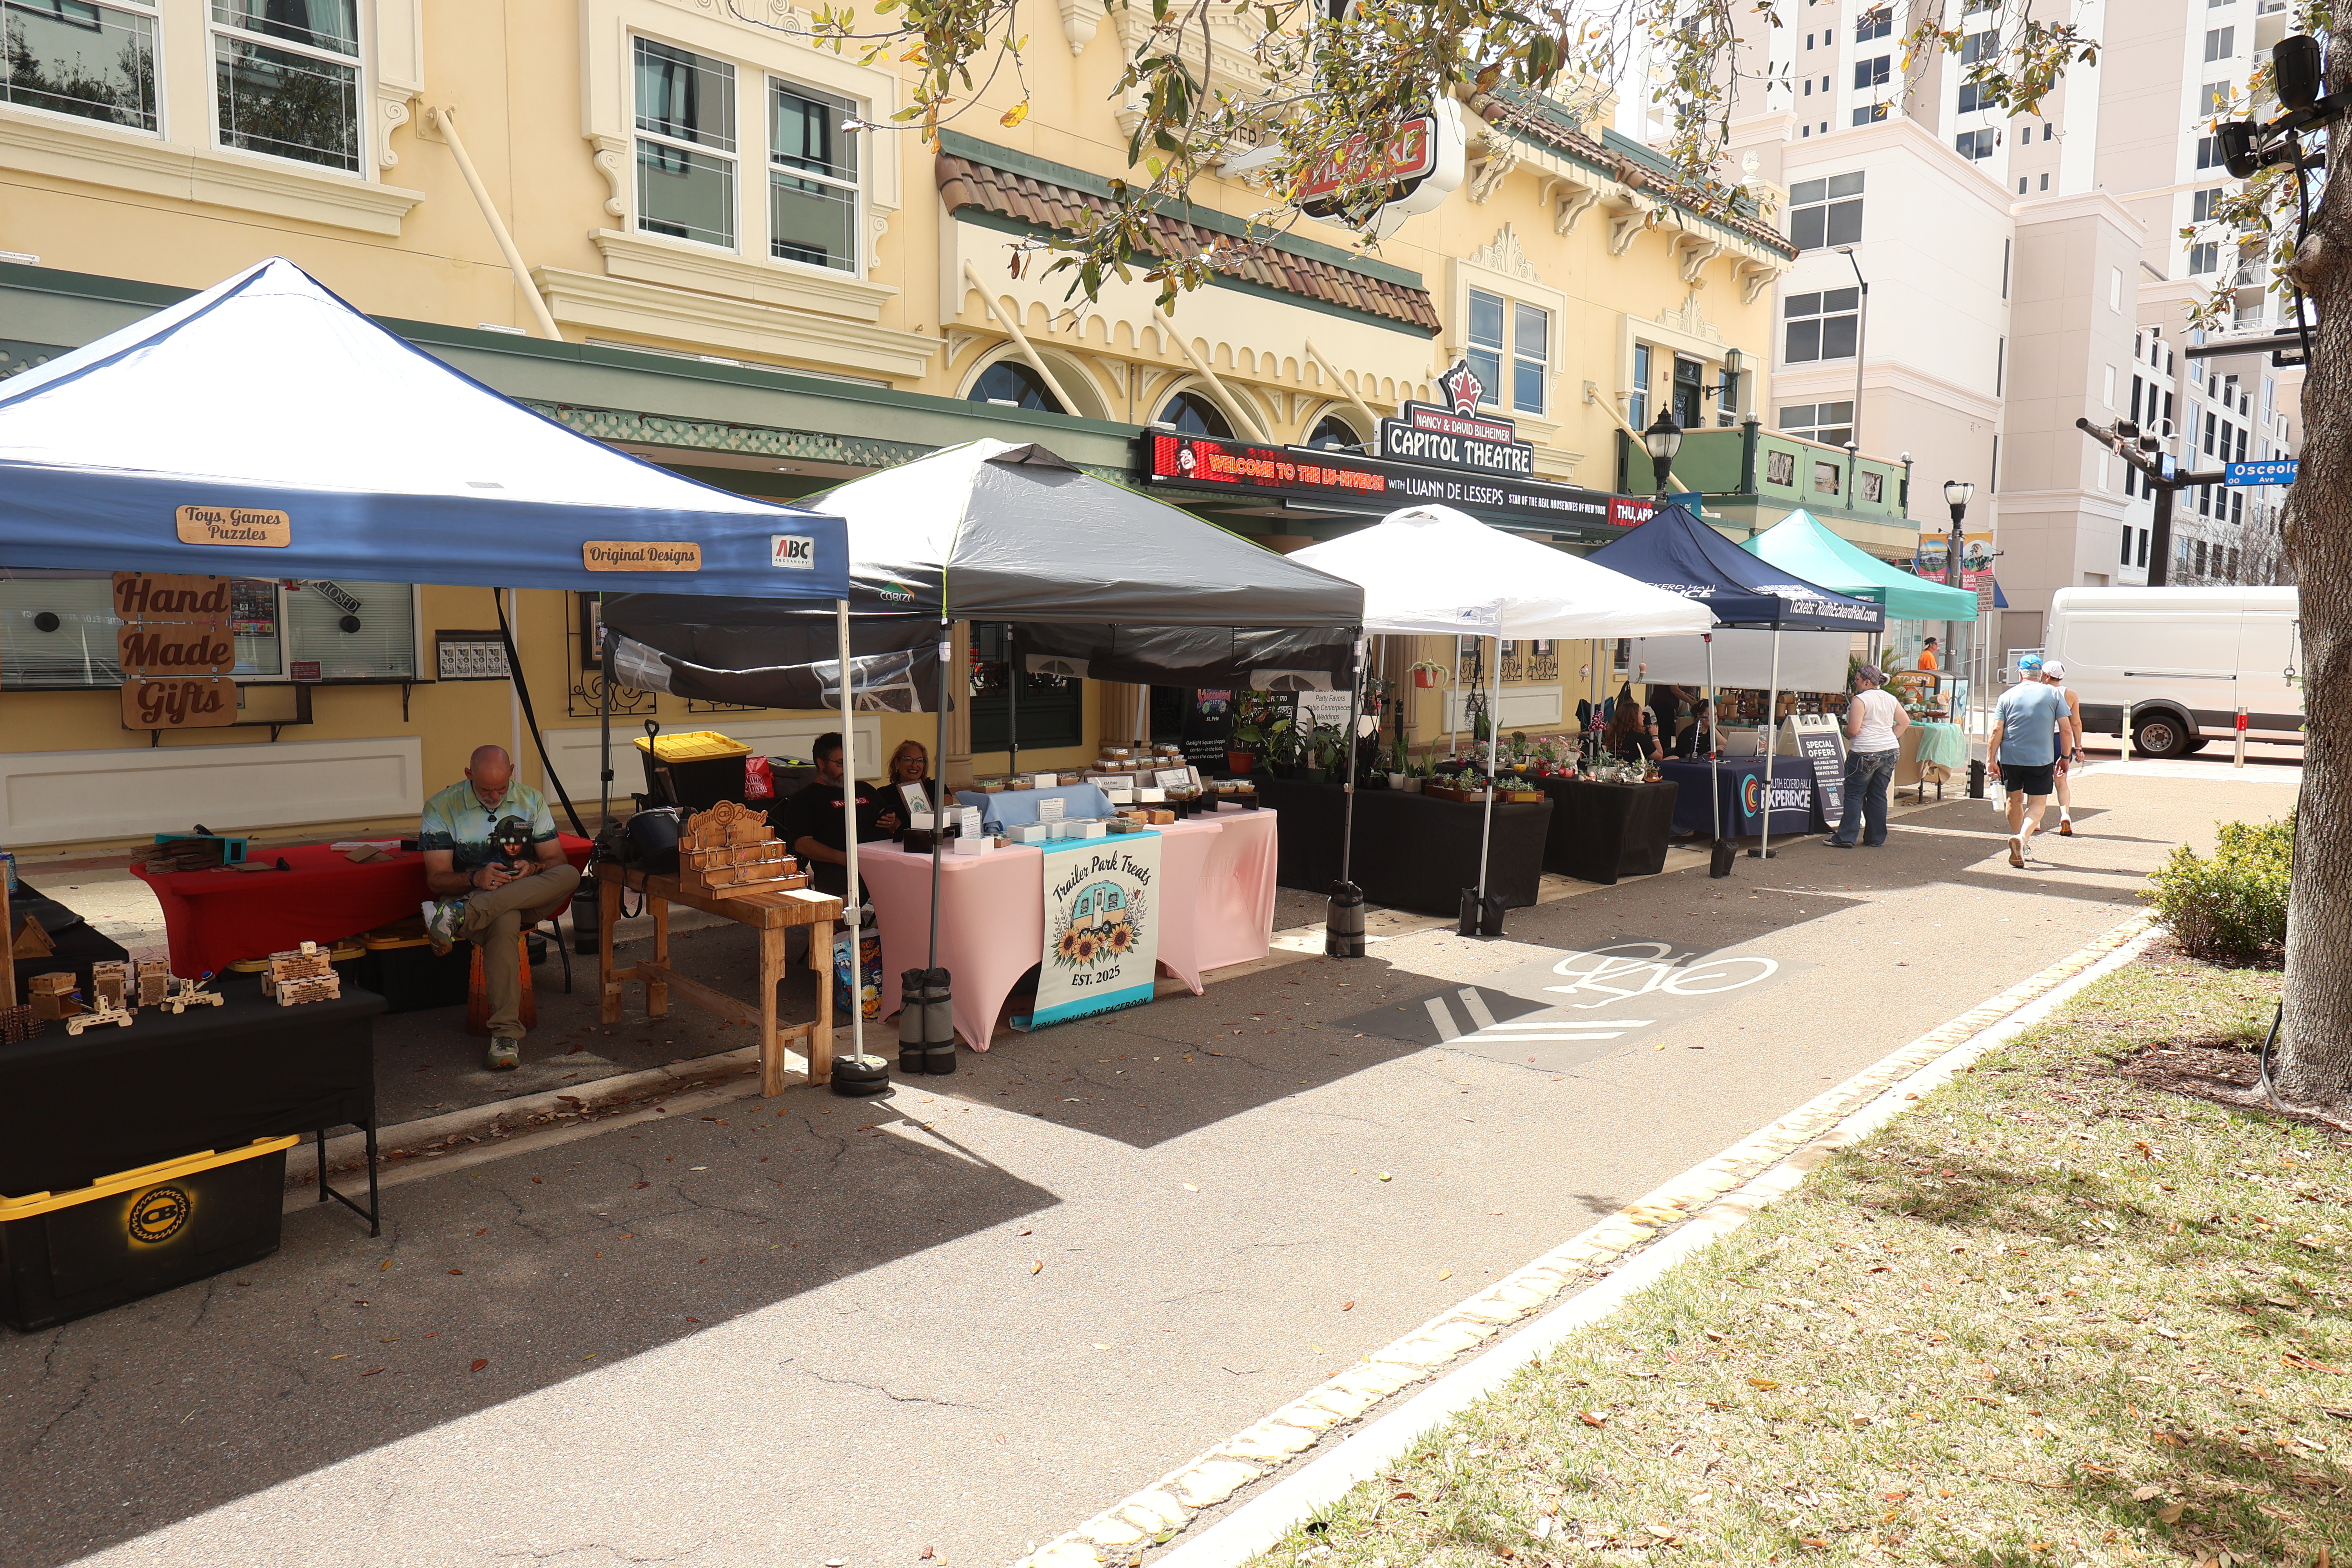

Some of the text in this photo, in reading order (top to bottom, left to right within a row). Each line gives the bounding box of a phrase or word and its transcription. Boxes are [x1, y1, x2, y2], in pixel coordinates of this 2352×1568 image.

[1416, 414, 1510, 442] NANCY & DAVID BILHEIMER
[1391, 428, 1530, 473] CAPITOL THEATRE
[2235, 462, 2298, 476] Osceola
[1209, 454, 1606, 515] WELCOME TO THE LU-NIVERSE WITH LUANN DE LESSEPS STAR OF THE REAL HOUSEWIVES OF NEW YORK
[185, 507, 282, 526] Toys, Games
[1617, 505, 1653, 523] THU, APR
[208, 525, 267, 541] Puzzles
[590, 547, 695, 565] Original Designs
[776, 539, 810, 559] ABC
[116, 579, 229, 613] Hand
[317, 581, 358, 612] CLOSED
[880, 591, 911, 603] COBIZI
[1790, 599, 1878, 622] Tickets: RuthEckerdHall.com
[123, 633, 231, 666] Made
[138, 681, 225, 724] Gifts
[1806, 740, 1834, 749] SPECIAL
[1808, 748, 1836, 757] OFFERS
[749, 784, 768, 794] DIXIE
[1770, 778, 1783, 789] RUTH
[1800, 779, 1811, 789] HALL
[1760, 790, 1811, 809] EXPERIENCE
[689, 811, 714, 831] Canton
[733, 805, 767, 824] Branch
[1053, 850, 1151, 903] Trailer Park Treats
[1071, 964, 1120, 986] EST. 2025
[1088, 1008, 1103, 1017] ON
[1104, 996, 1149, 1014] FACEBOOK
[142, 1204, 178, 1225] CB
